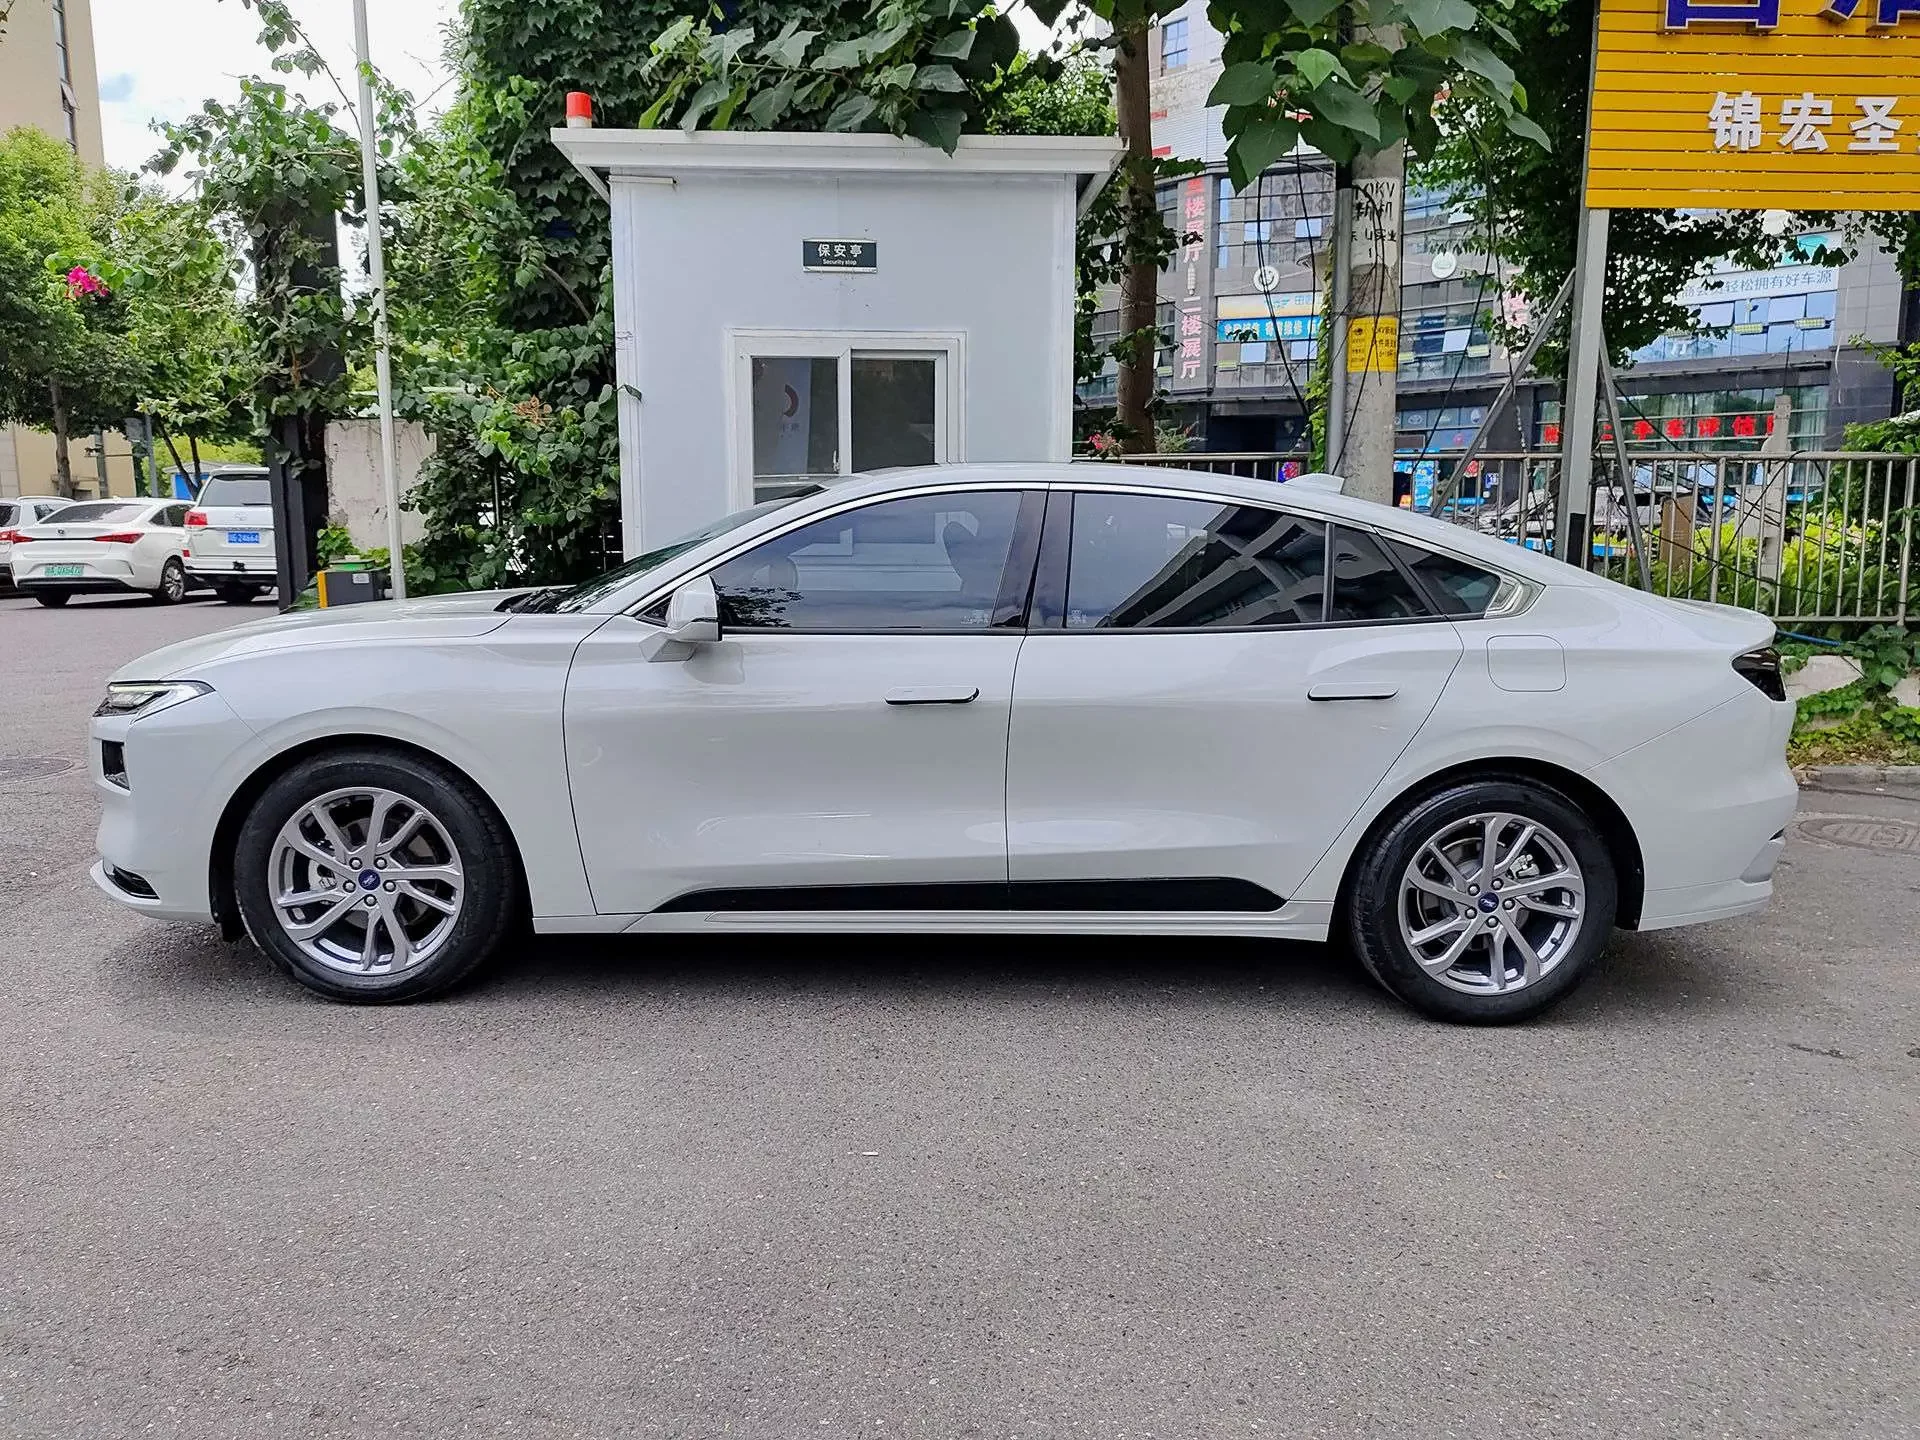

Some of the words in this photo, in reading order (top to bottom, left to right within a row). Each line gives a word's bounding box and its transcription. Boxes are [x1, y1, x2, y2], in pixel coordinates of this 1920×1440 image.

[1708, 91, 1920, 152] 锦宏圣
[818, 243, 862, 258] 保安亭
[822, 258, 844, 266] Security
